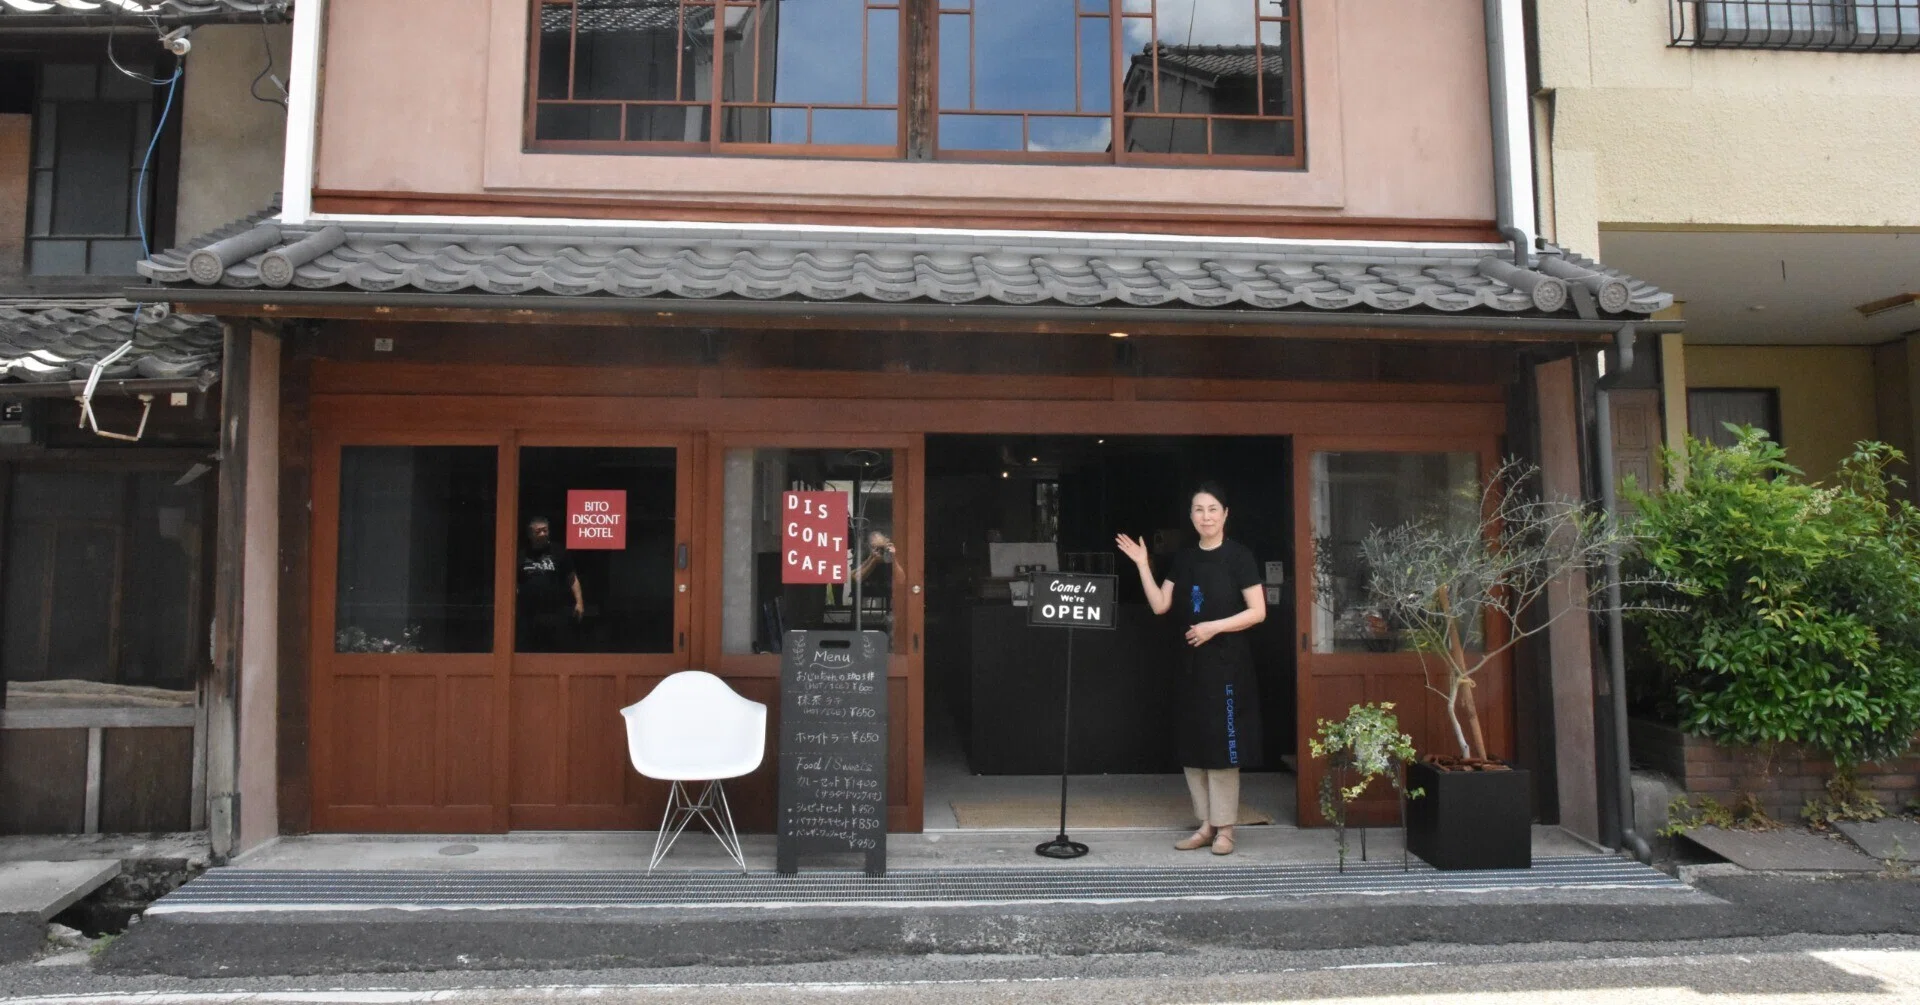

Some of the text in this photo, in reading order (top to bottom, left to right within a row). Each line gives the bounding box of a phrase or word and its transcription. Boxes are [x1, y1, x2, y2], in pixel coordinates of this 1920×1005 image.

[584, 501, 610, 512] BITO
[788, 494, 828, 519] DIS
[572, 514, 621, 525] DISCONT
[578, 527, 614, 538] HOTEL
[788, 522, 843, 552] CONT
[787, 549, 842, 580] CAFE
[1049, 579, 1097, 593] Come In
[1060, 594, 1085, 603] We're
[1041, 604, 1101, 621] OPEN
[813, 650, 851, 663] Menu
[850, 707, 876, 718] ¥650
[1225, 684, 1238, 764] LE CORDON BLEU
[851, 731, 880, 744] ¥650
[844, 776, 878, 789] ¥1400
[852, 817, 880, 830] ¥850
